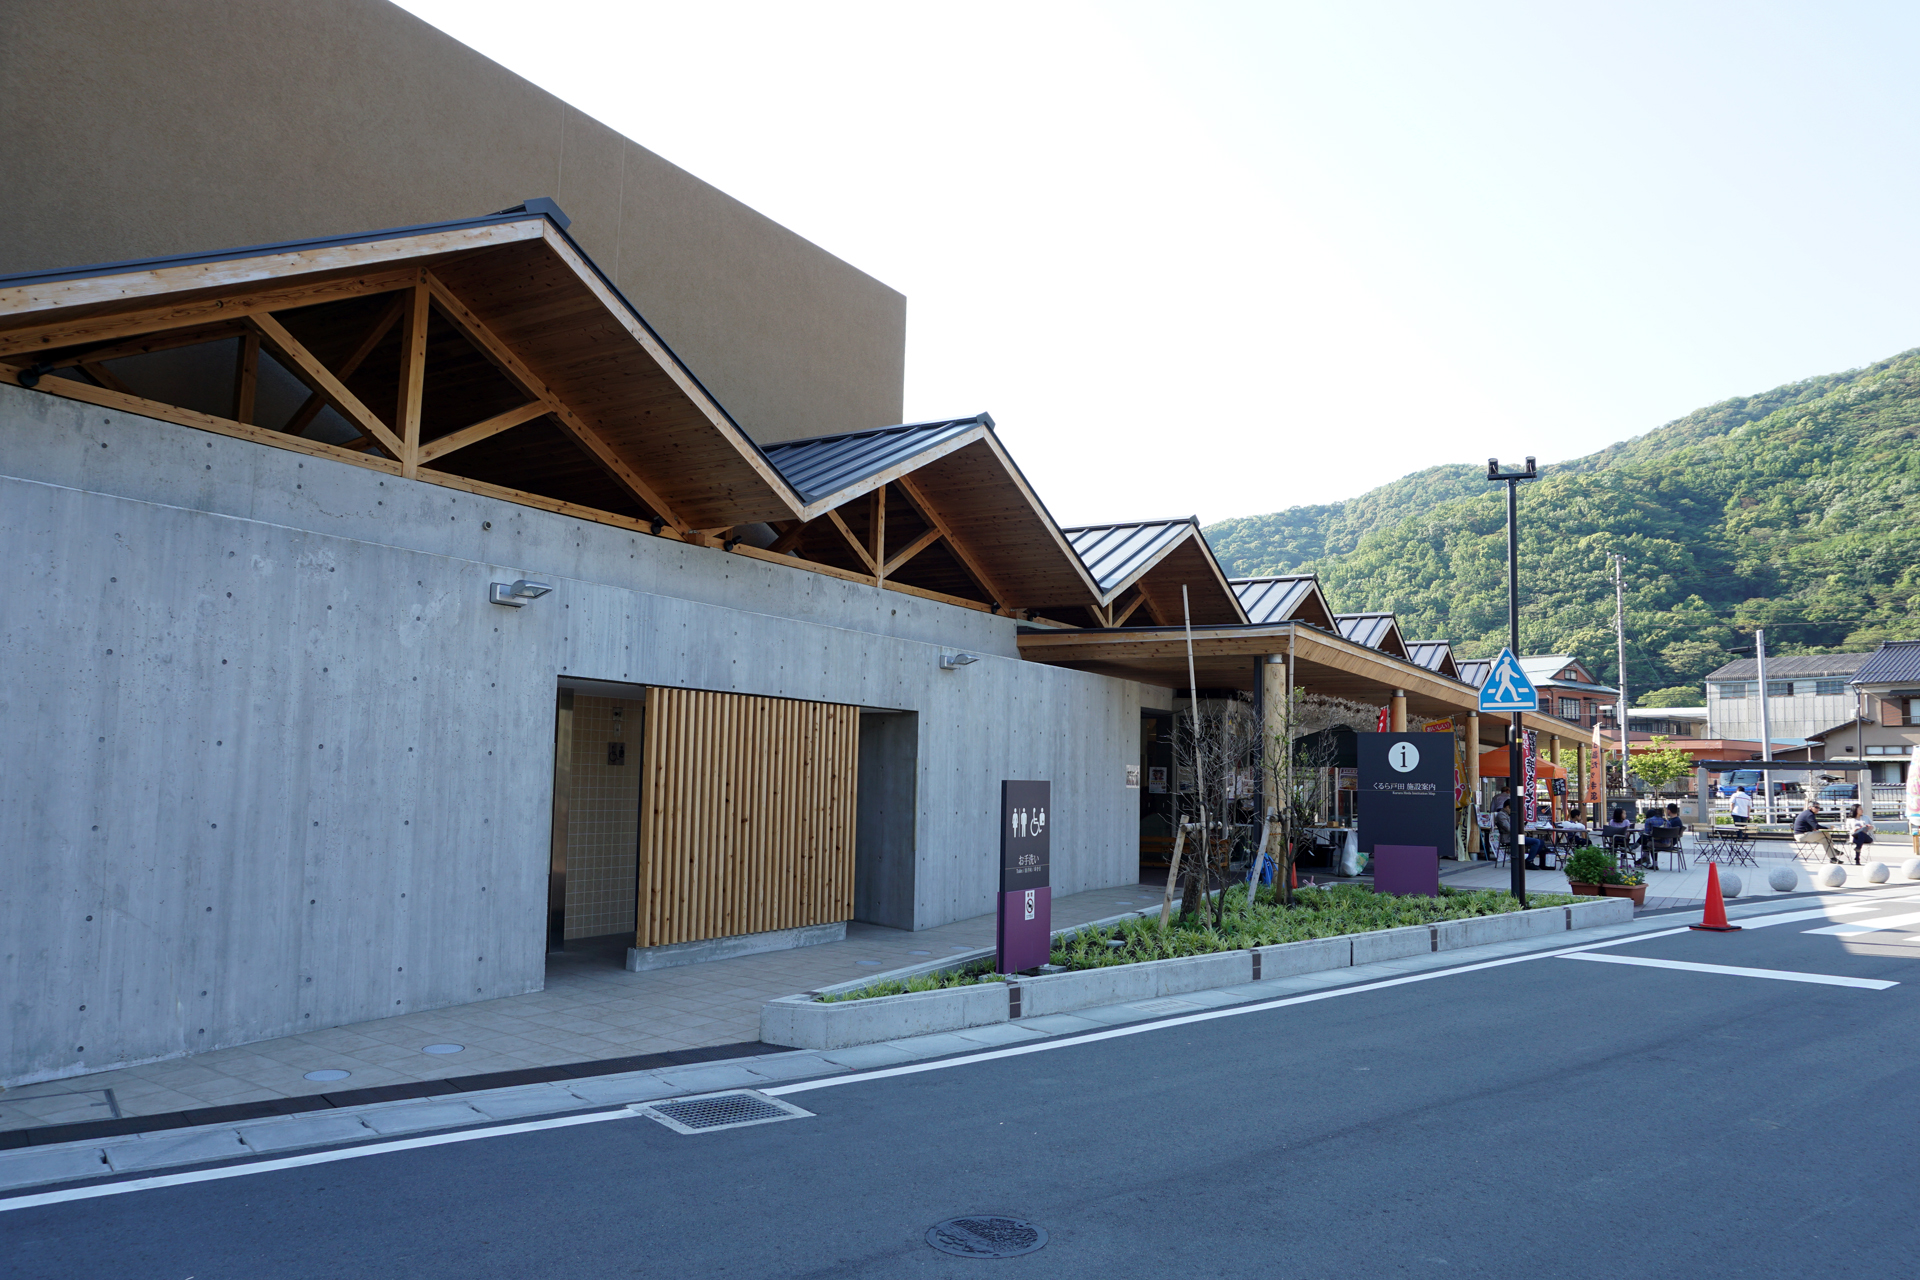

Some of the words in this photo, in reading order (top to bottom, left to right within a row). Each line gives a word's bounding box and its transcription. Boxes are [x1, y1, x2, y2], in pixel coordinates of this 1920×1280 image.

[1400, 745, 1408, 768] i
[1373, 782, 1405, 790] くるら戸田
[1406, 782, 1436, 791] 施設案内
[1018, 854, 1039, 865] お手洗い
